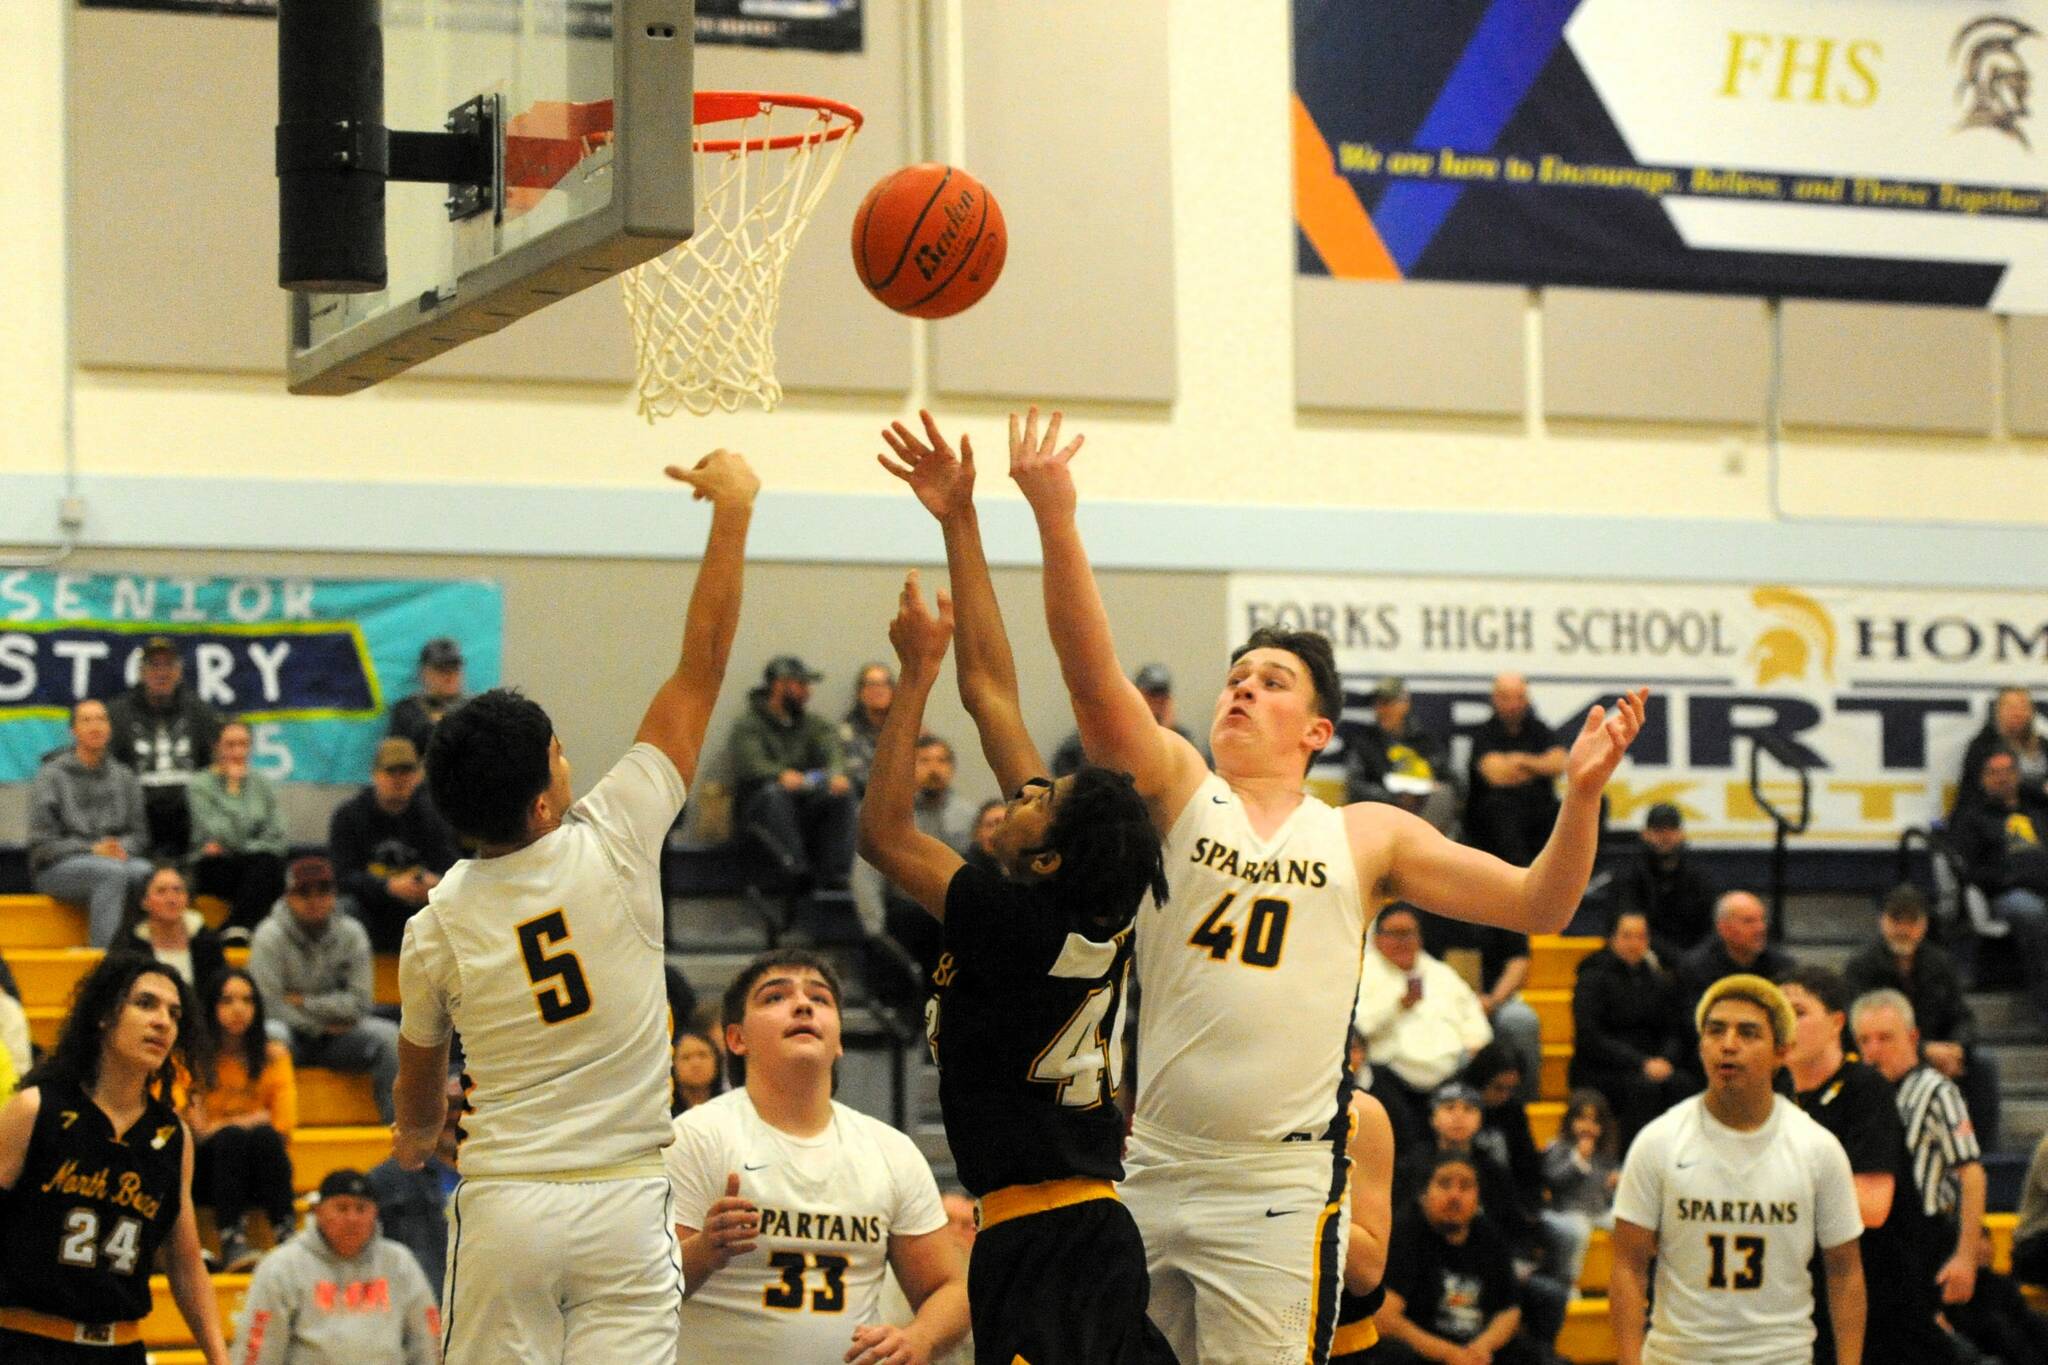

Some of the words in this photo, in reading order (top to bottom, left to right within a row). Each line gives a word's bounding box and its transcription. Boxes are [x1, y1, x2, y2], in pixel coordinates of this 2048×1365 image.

[1716, 30, 1885, 110] FHS
[1338, 142, 1383, 174] We
[1386, 152, 1434, 176] are
[1440, 147, 1499, 180] here
[1505, 156, 1535, 182] to
[1793, 175, 1845, 200] and
[913, 190, 976, 281] Baden
[0, 571, 316, 623] SENIOR
[1421, 606, 1534, 652] HIGH
[1555, 606, 1736, 657] SCHOOL
[1187, 889, 1291, 972] 40
[513, 906, 595, 1028] 5
[58, 1206, 143, 1276] 24
[747, 1208, 881, 1244] PARTANS
[1677, 1198, 1799, 1225] SPARTANS
[762, 1249, 850, 1317] 33
[1706, 1231, 1766, 1293] 13
